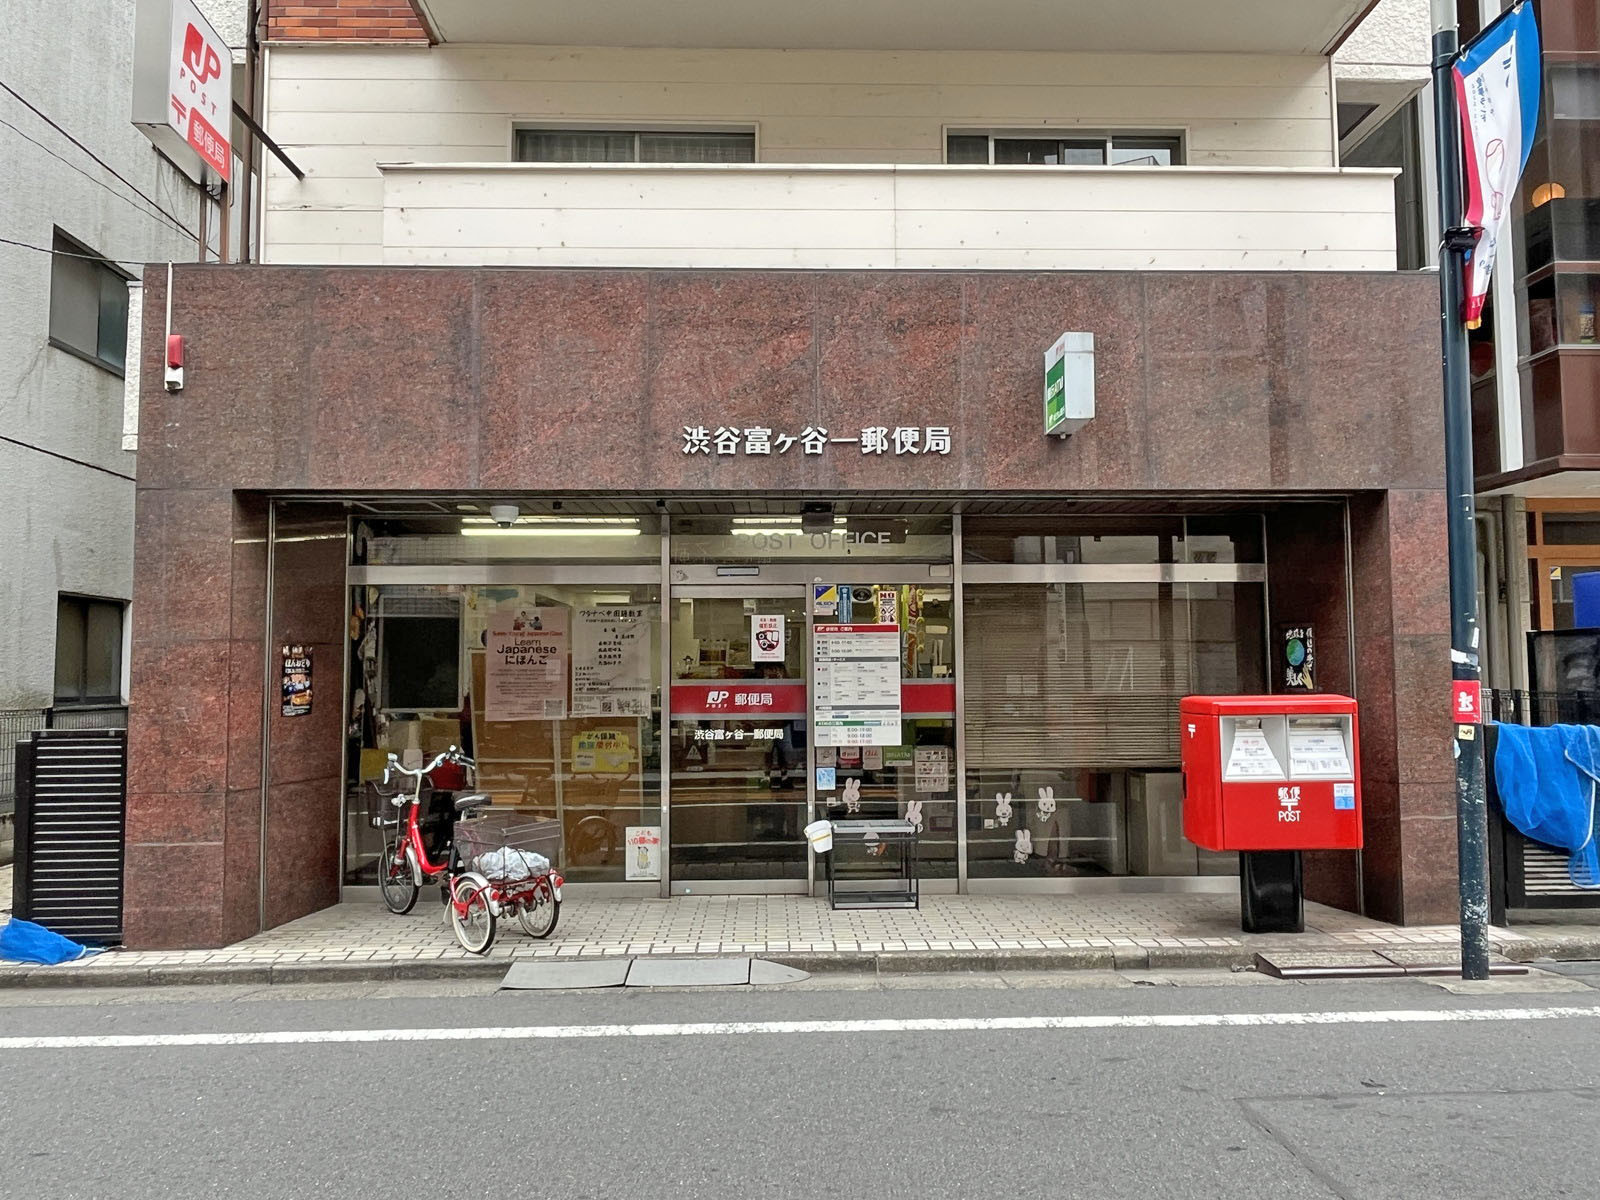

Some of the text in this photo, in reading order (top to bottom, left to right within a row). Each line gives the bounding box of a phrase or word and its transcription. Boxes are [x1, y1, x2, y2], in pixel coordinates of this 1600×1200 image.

[180, 67, 217, 117] POST
[193, 119, 225, 169] 郵便局
[810, 531, 891, 550] OFFICE
[514, 638, 541, 646] Learn
[497, 645, 557, 655] Japanese
[734, 693, 773, 706] 郵便局
[1278, 786, 1301, 800] 郵便
[1278, 810, 1301, 822] POST
